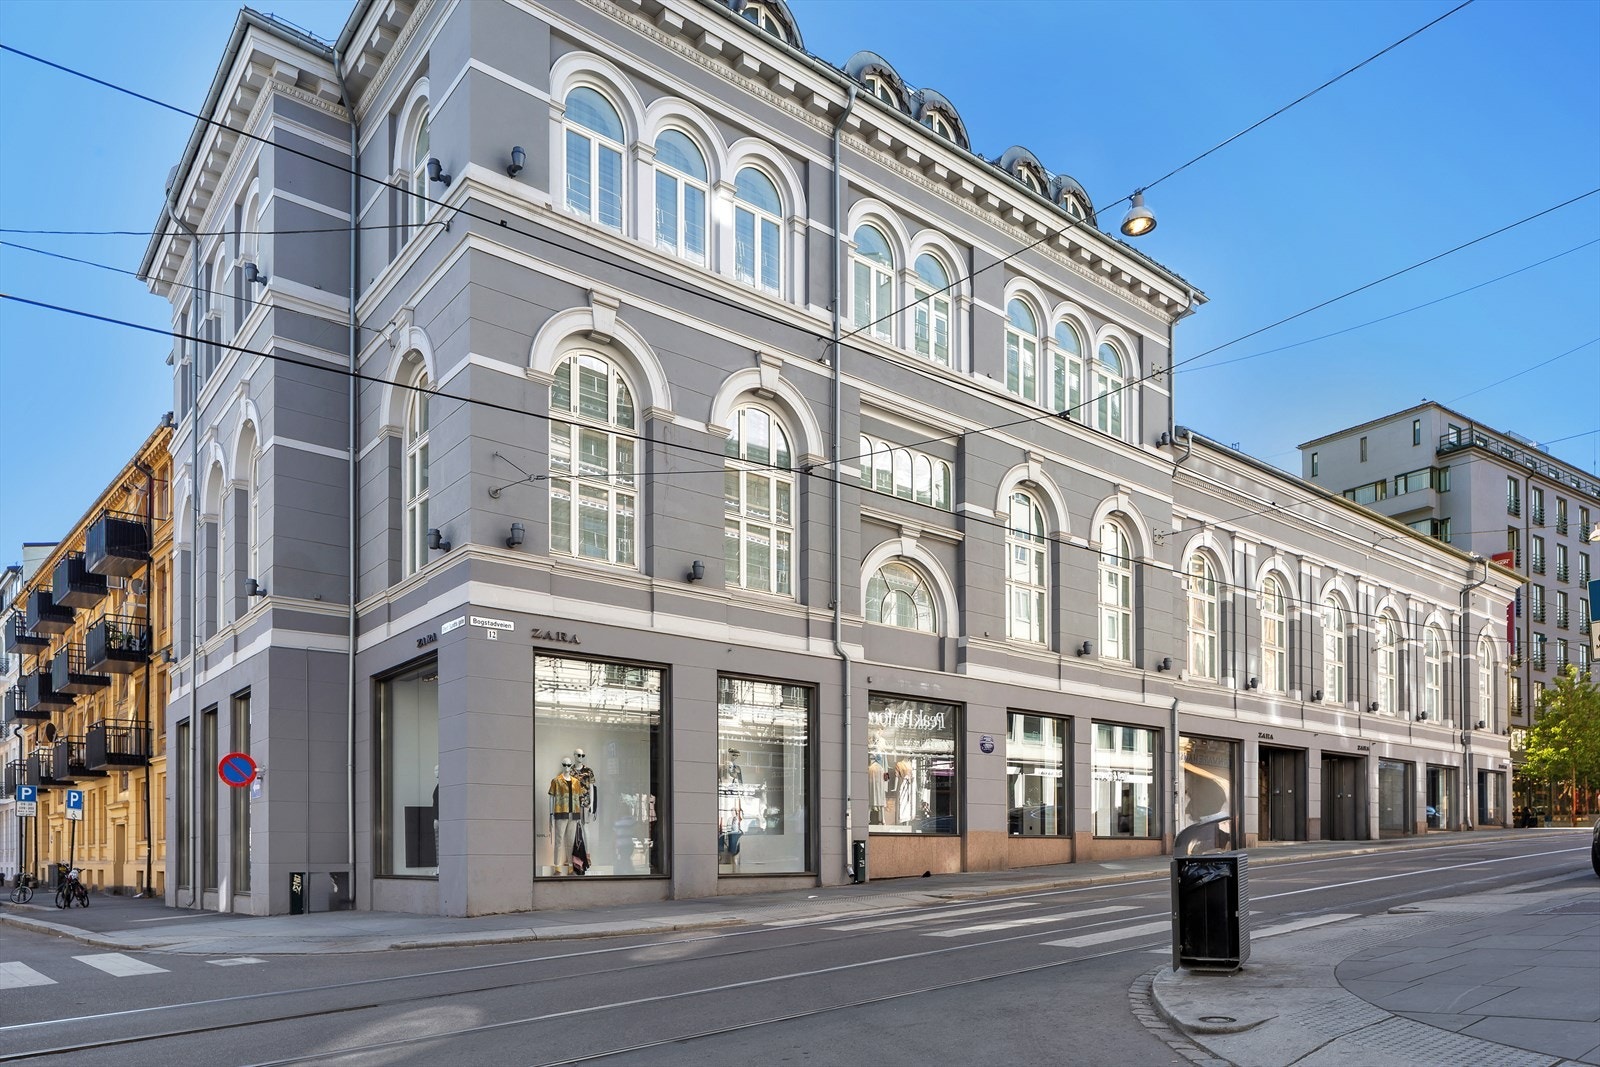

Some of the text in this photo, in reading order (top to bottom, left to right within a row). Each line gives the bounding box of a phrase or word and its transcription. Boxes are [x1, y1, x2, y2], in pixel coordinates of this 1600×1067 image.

[472, 617, 512, 629] Bogstadveien
[489, 631, 496, 639] 12
[531, 628, 581, 645] ZARA
[1258, 732, 1274, 740] ZARA
[21, 787, 32, 800] P
[70, 792, 79, 807] P
